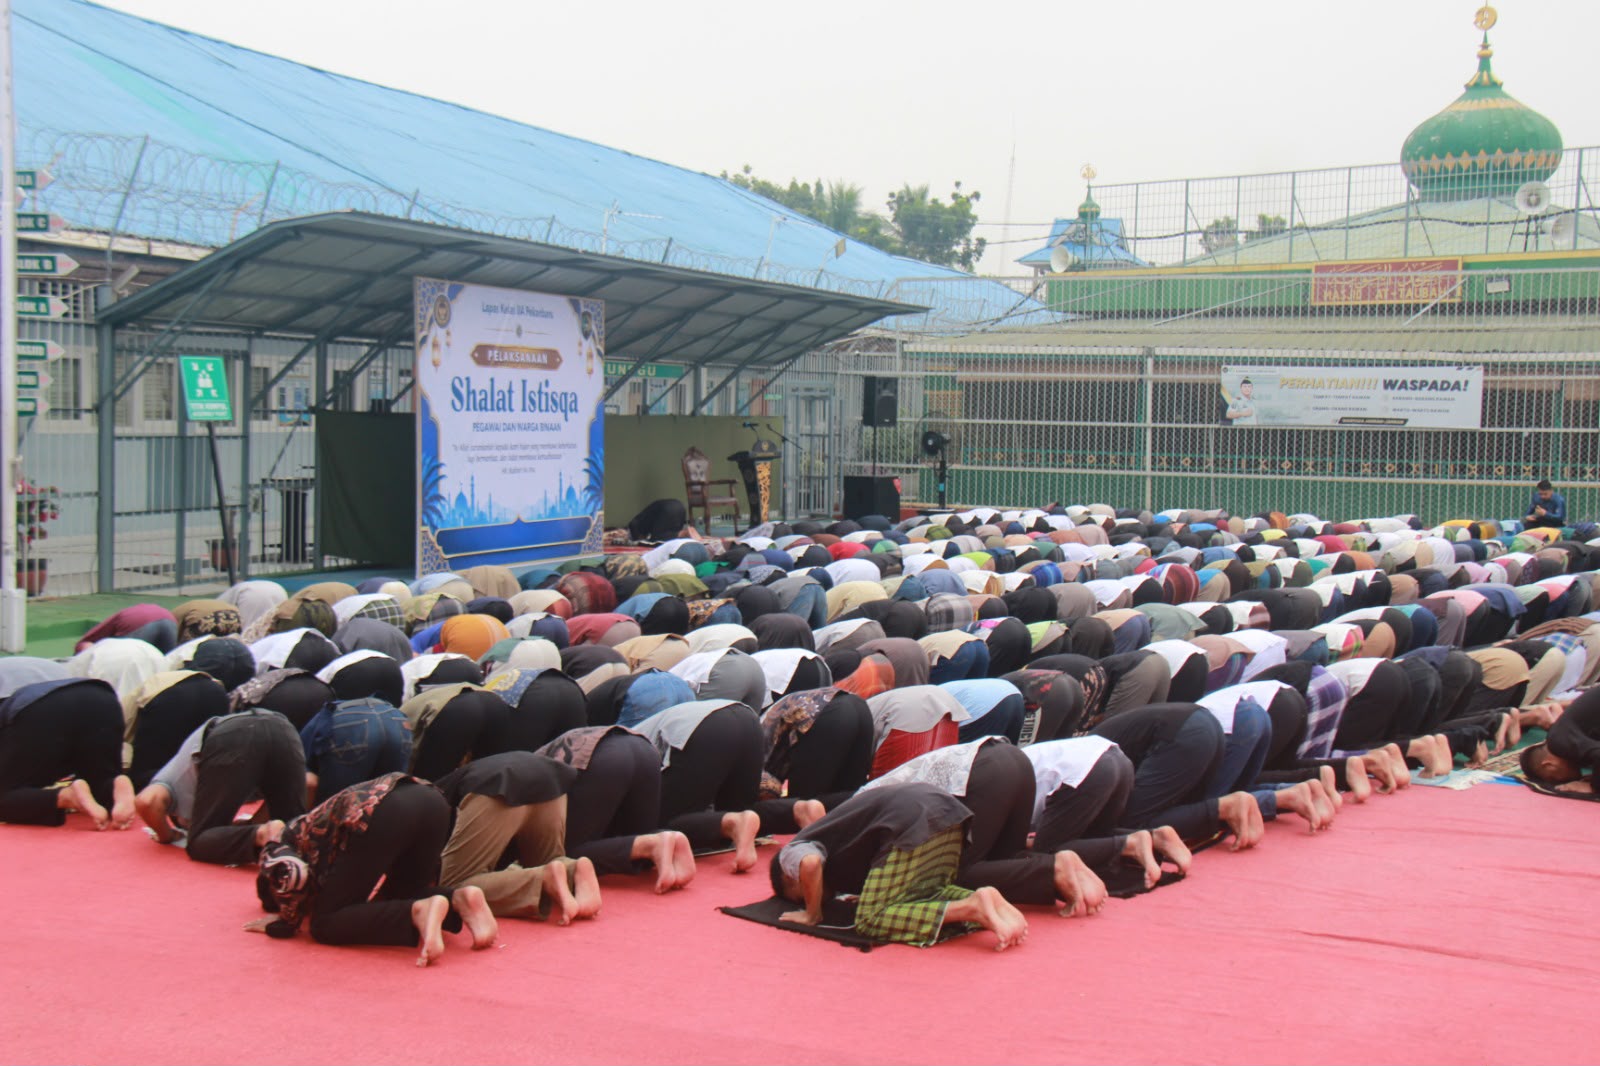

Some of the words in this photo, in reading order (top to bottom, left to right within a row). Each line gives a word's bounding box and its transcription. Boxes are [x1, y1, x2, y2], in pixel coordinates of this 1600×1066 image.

[37, 217, 47, 229] C
[487, 349, 548, 365] PELAKSANAAN
[607, 363, 656, 377] UNGU
[1279, 376, 1379, 391] PERHATIAN!!!
[1382, 379, 1469, 392] WASPADA!
[451, 375, 515, 413] Shalat
[521, 378, 579, 422] Istisqa
[502, 422, 516, 432] DAN
